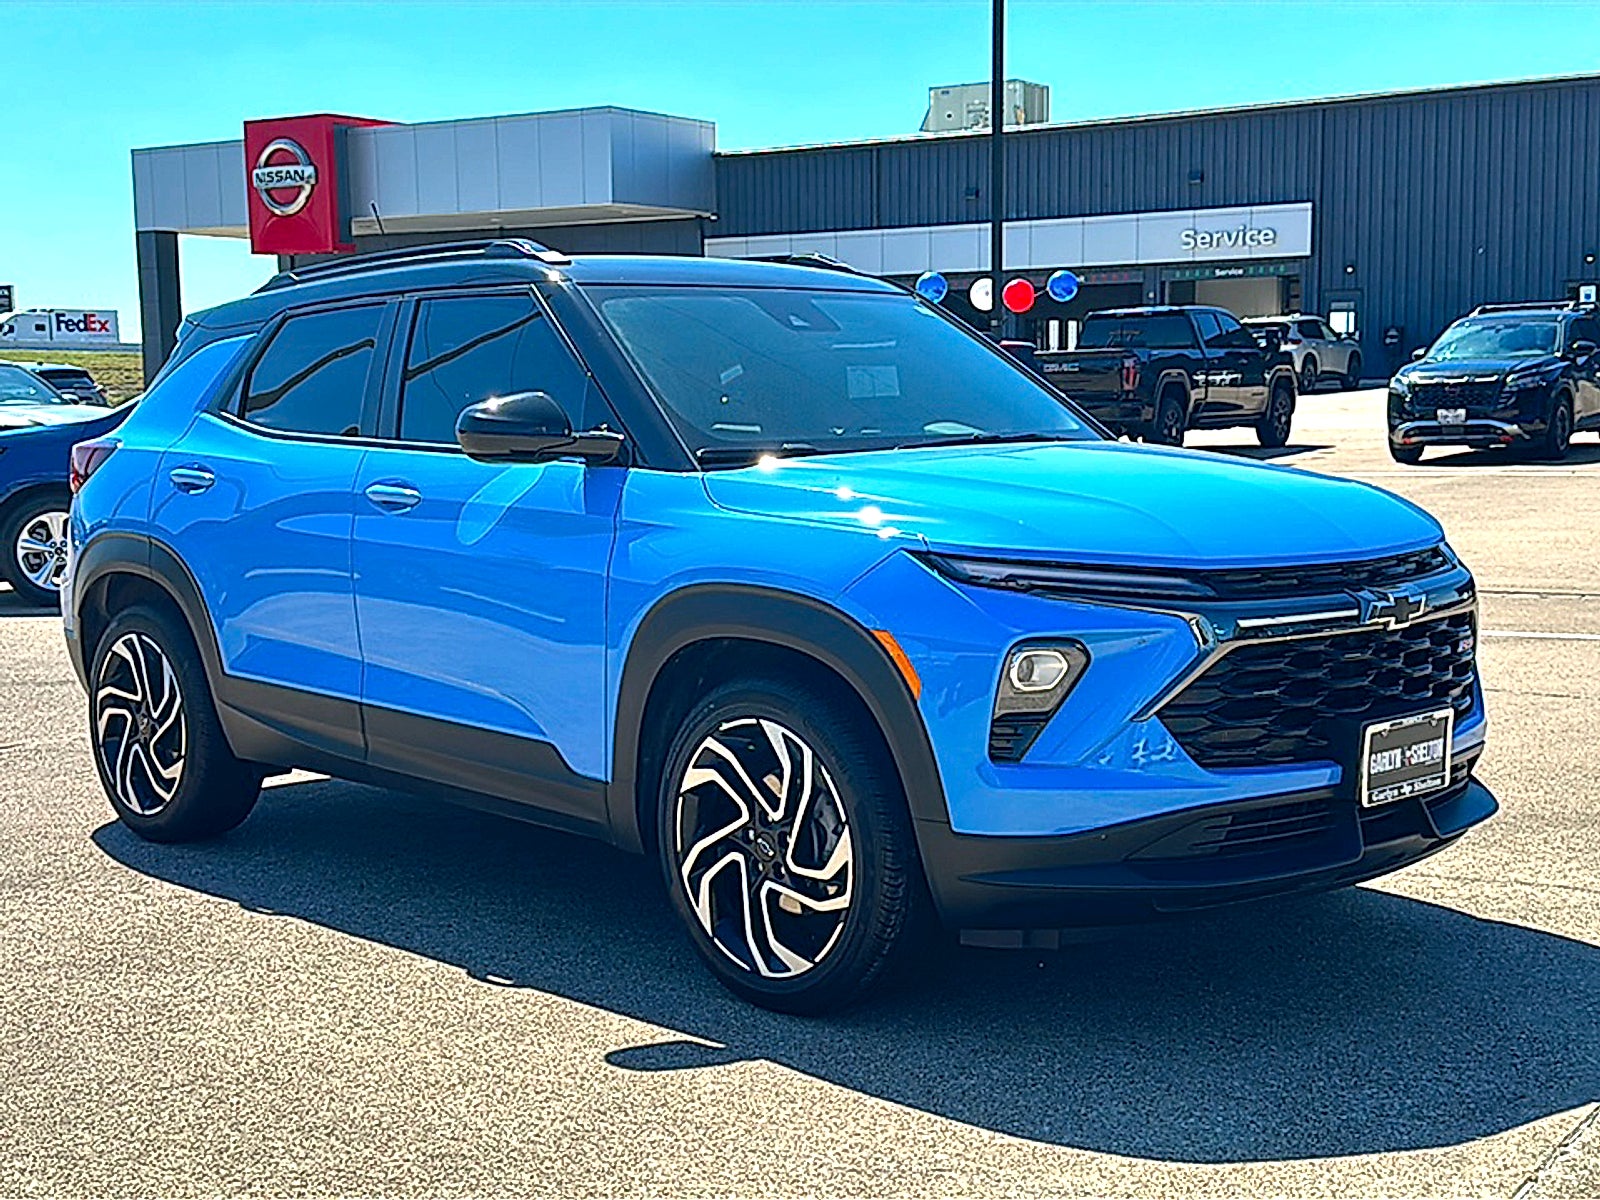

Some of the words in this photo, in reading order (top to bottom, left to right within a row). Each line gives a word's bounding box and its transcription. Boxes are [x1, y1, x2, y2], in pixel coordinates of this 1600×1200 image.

[255, 169, 305, 184] NISSAN
[1180, 224, 1277, 250] Service
[1214, 267, 1245, 277] Service
[55, 312, 110, 333] FedEx
[1043, 362, 1080, 373] GMC
